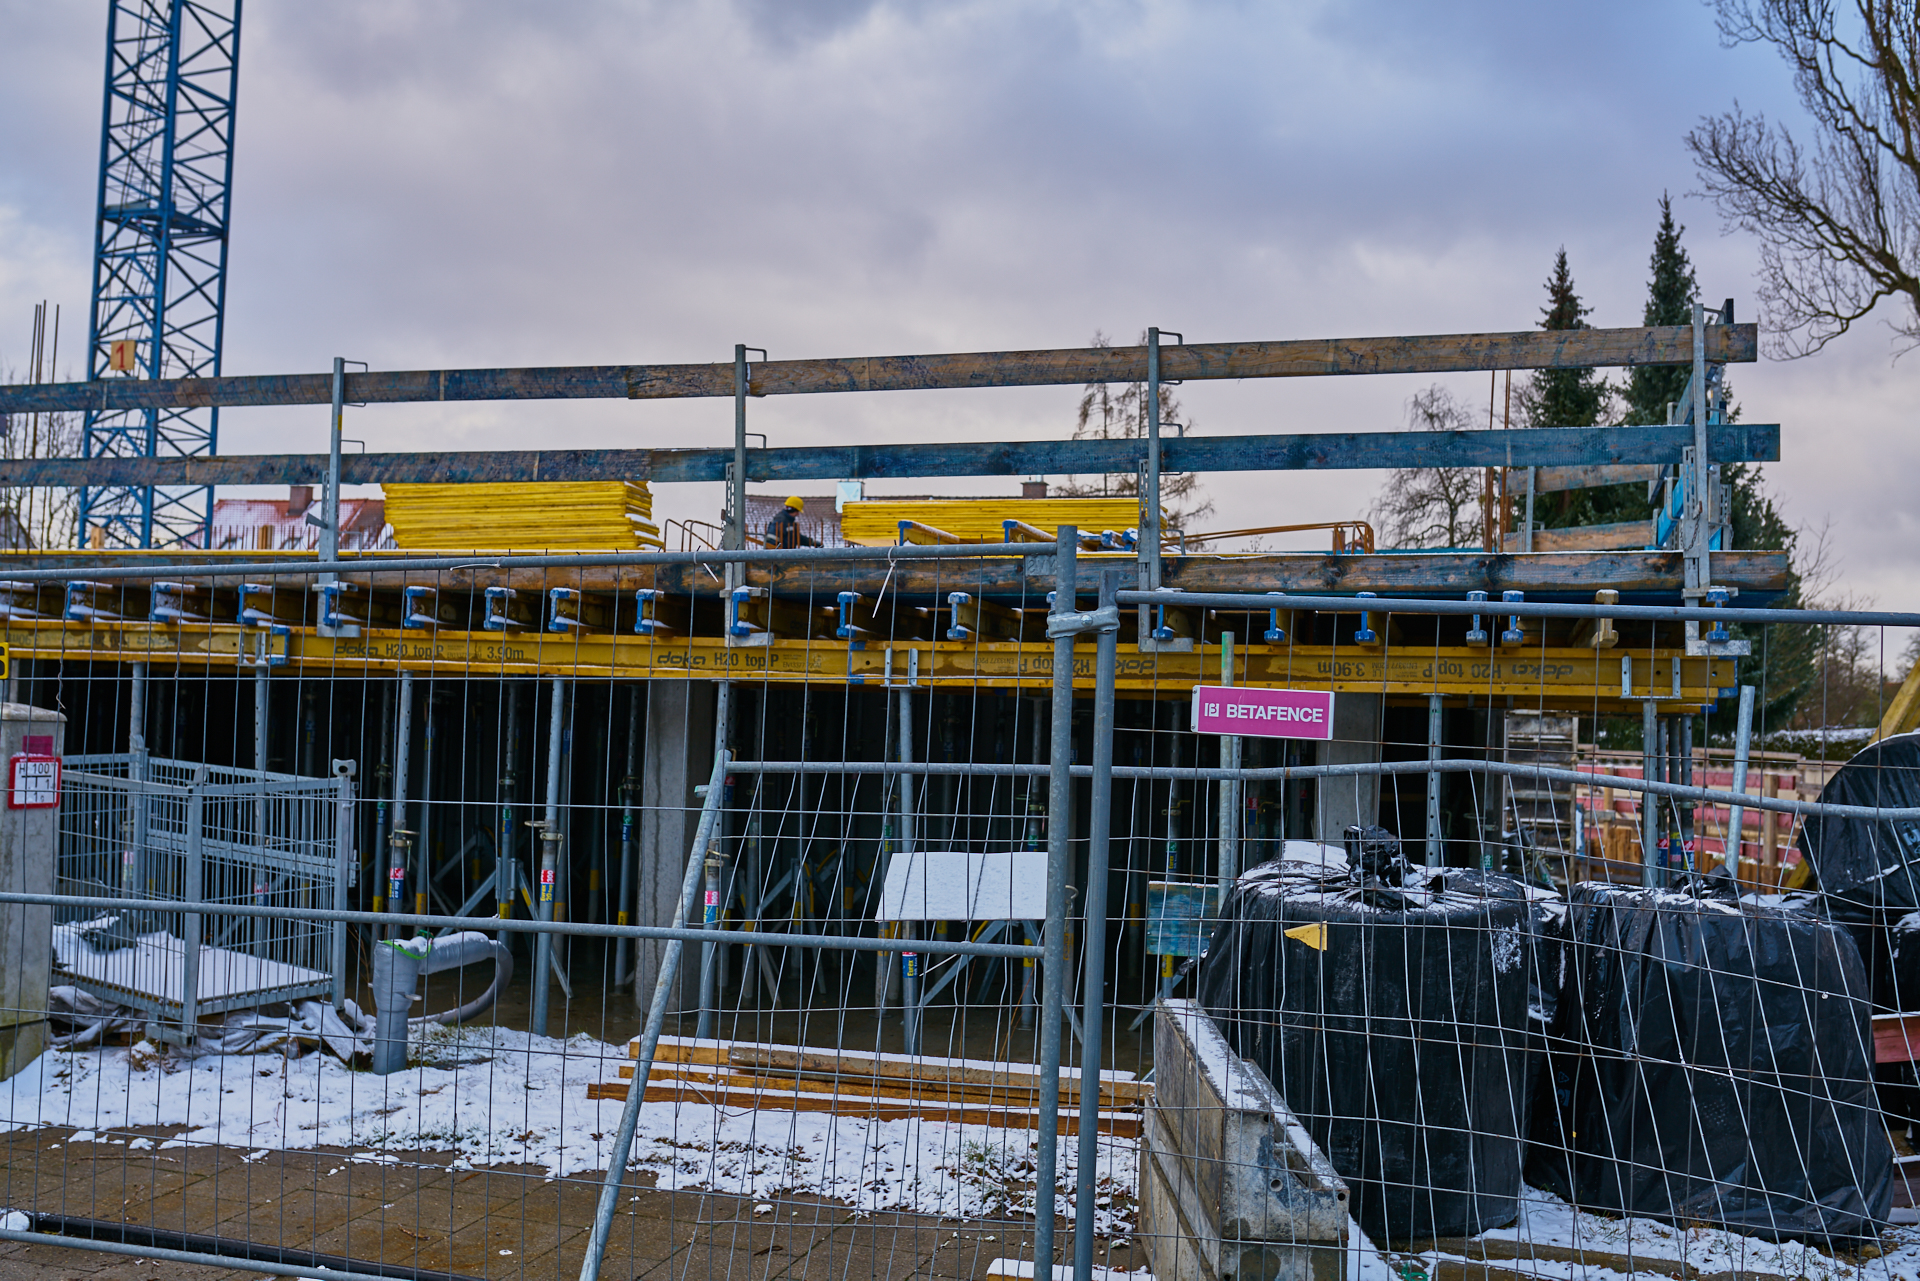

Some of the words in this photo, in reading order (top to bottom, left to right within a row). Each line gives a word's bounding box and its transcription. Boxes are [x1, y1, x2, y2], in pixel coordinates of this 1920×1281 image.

[116, 342, 125, 369] 1
[334, 642, 379, 655] doka
[386, 643, 408, 657] H20
[657, 651, 706, 665] doka
[714, 652, 739, 667] H20
[745, 653, 766, 668] top
[770, 654, 779, 667] P
[1116, 660, 1155, 674] dok
[1317, 661, 1365, 677] 3.90m
[1422, 663, 1432, 678] P
[1438, 660, 1464, 678] top
[1471, 663, 1501, 679] H20
[1512, 664, 1574, 679] doka
[1226, 703, 1324, 723] BETAFENCE
[33, 763, 50, 774] 100
